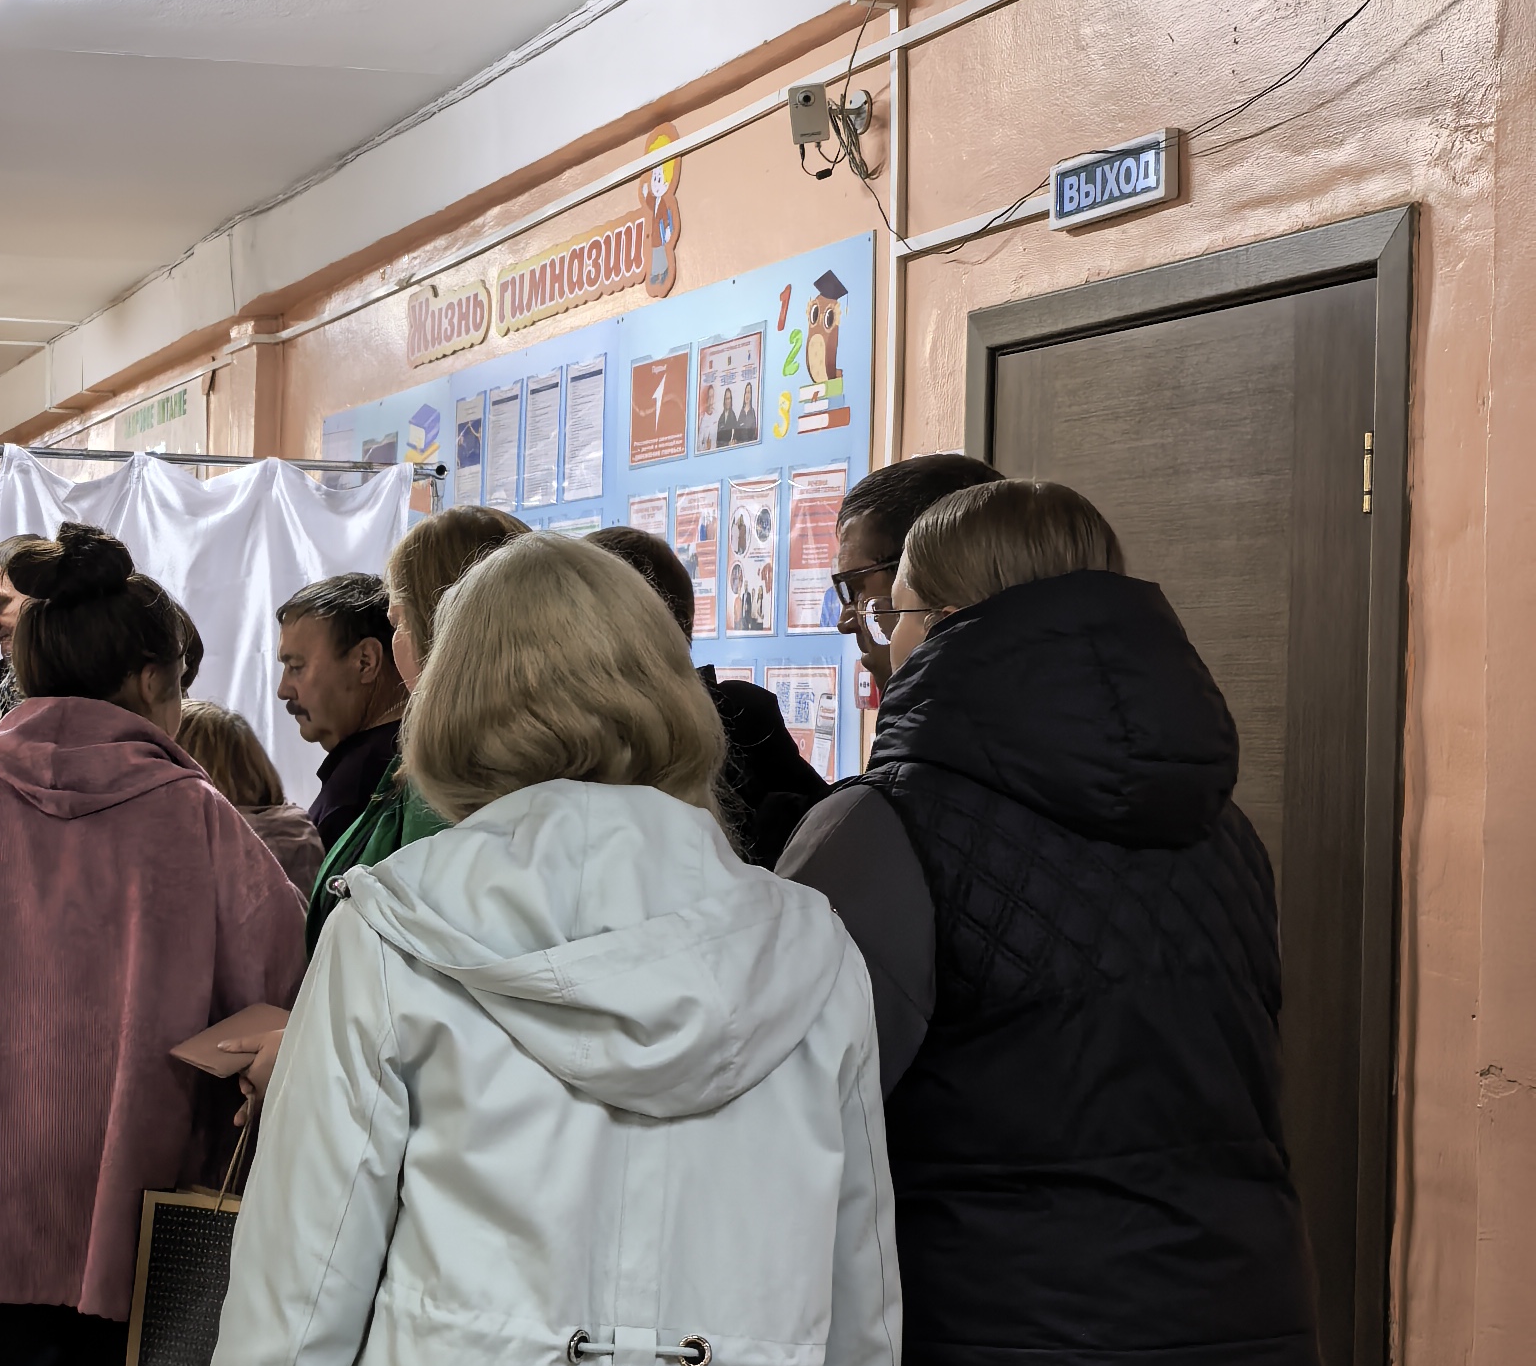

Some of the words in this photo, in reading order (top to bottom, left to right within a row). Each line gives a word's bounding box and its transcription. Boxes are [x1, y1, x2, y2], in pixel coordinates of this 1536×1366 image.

[1064, 149, 1157, 213] ВЫХОД
[408, 290, 486, 358] Жизнь
[497, 217, 646, 325] гимназии
[777, 283, 792, 332] 1
[782, 328, 803, 377] 2
[773, 391, 792, 439] 3
